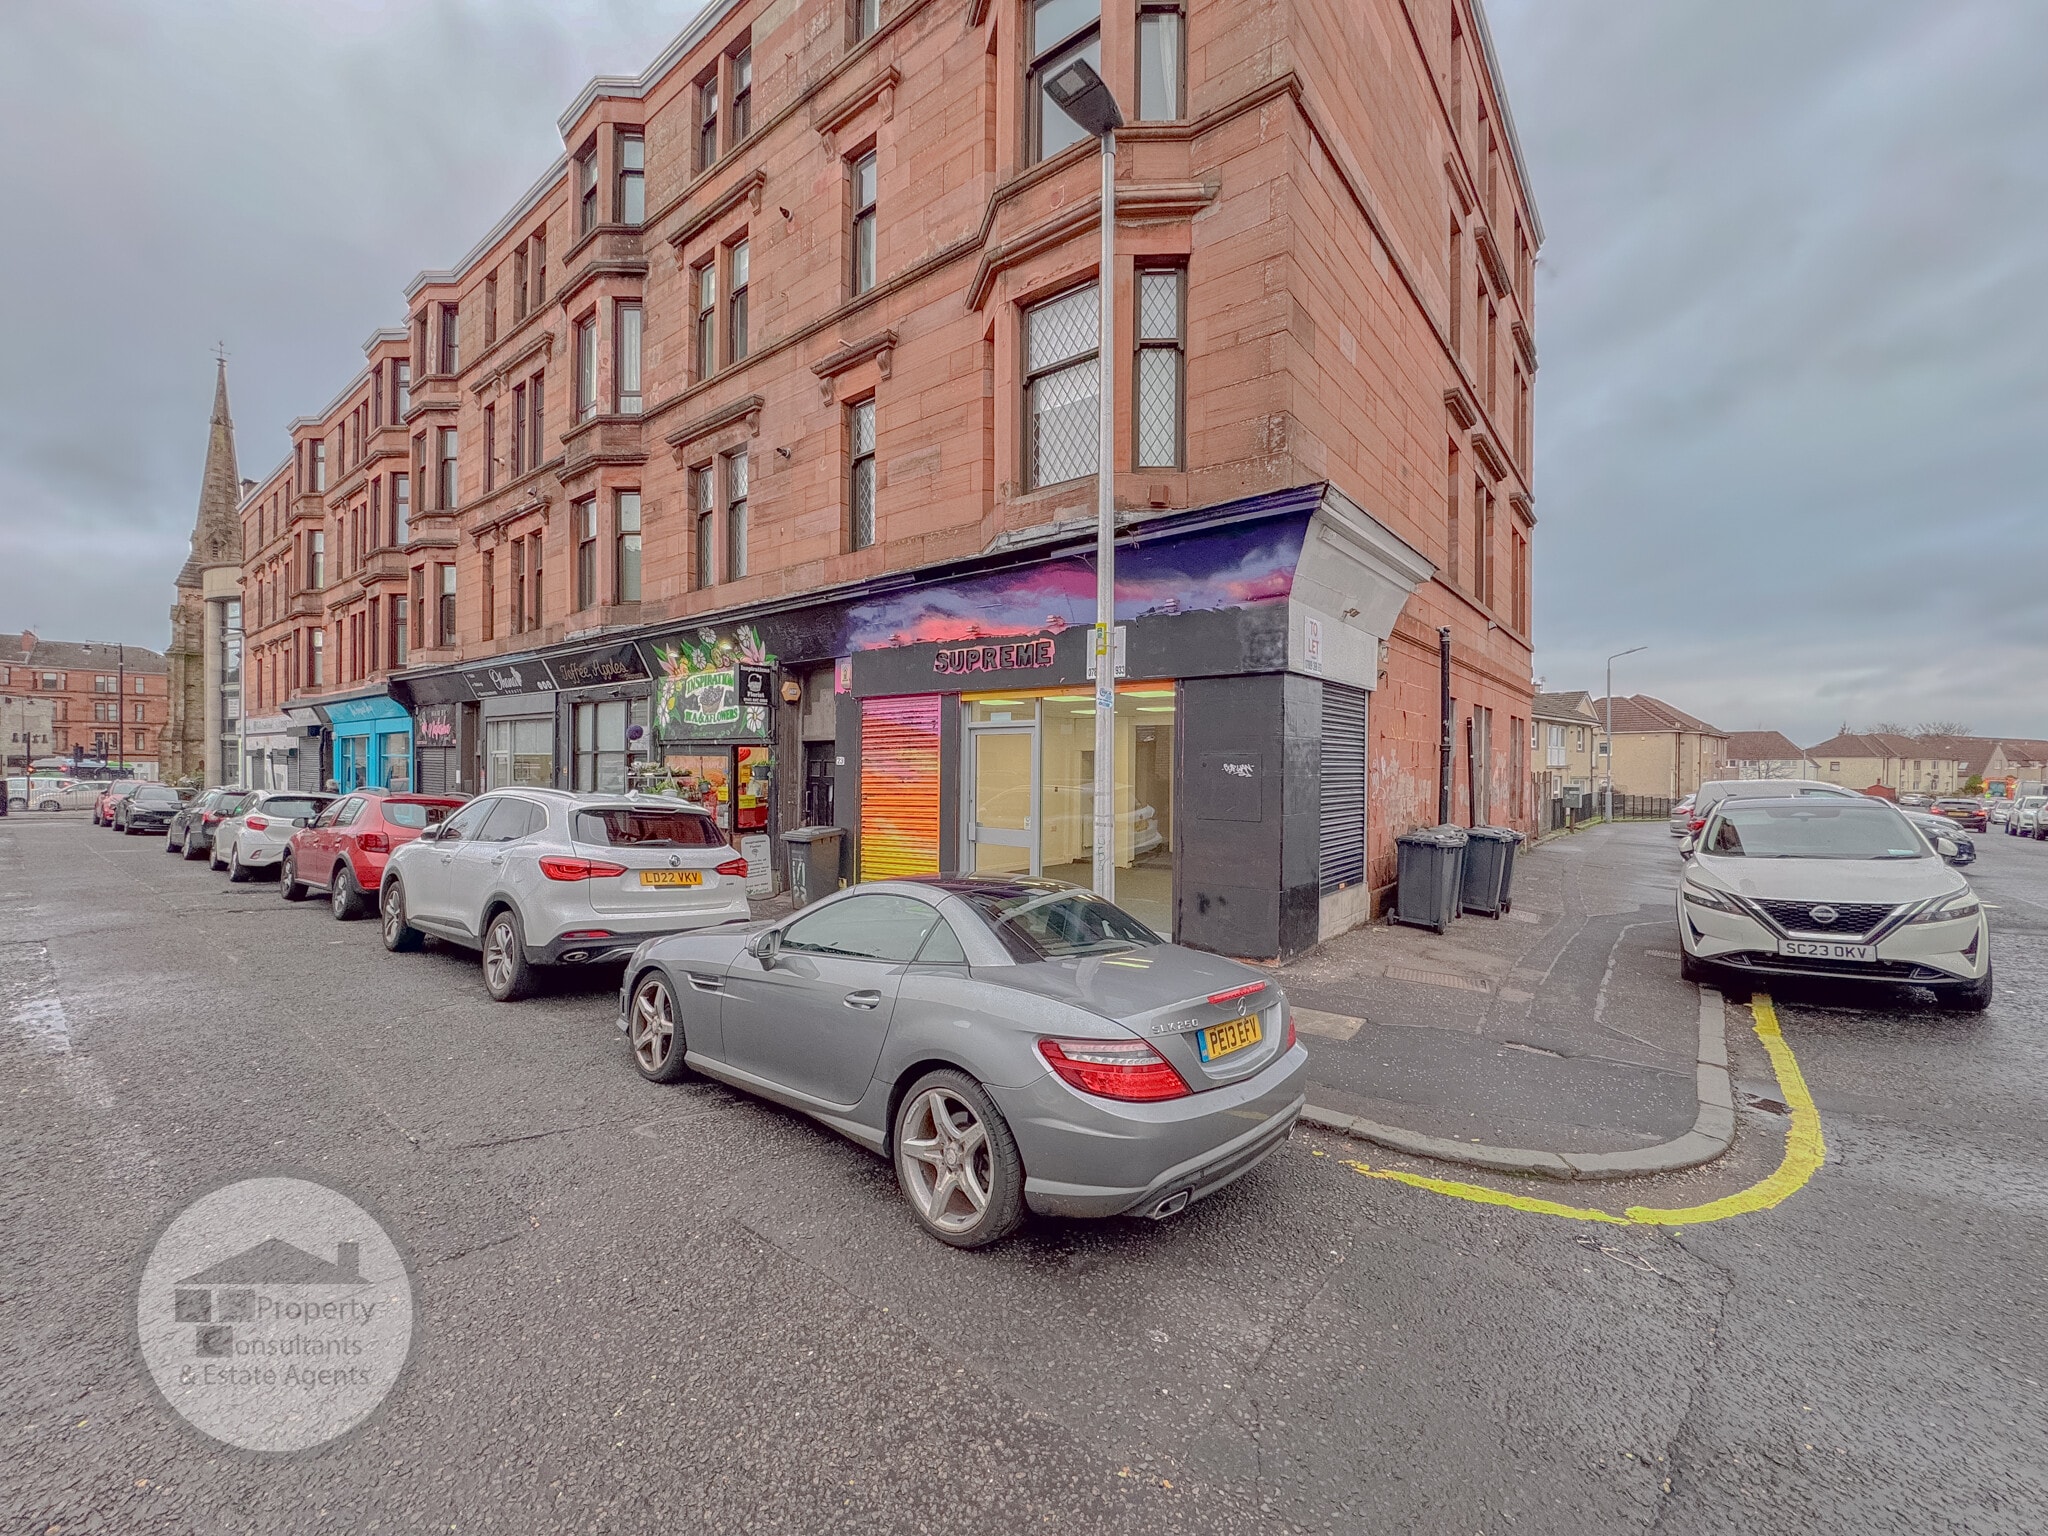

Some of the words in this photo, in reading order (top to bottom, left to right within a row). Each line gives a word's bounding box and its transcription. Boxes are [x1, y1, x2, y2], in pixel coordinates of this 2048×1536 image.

[1309, 620, 1318, 637] TO
[1308, 638, 1319, 656] LET
[935, 641, 1052, 672] SUPREME
[592, 658, 629, 680] Apples
[678, 871, 698, 883] VKV
[1786, 943, 1829, 956] SC23
[1209, 1025, 1237, 1055] PE13
[1238, 1016, 1257, 1043] EFV
